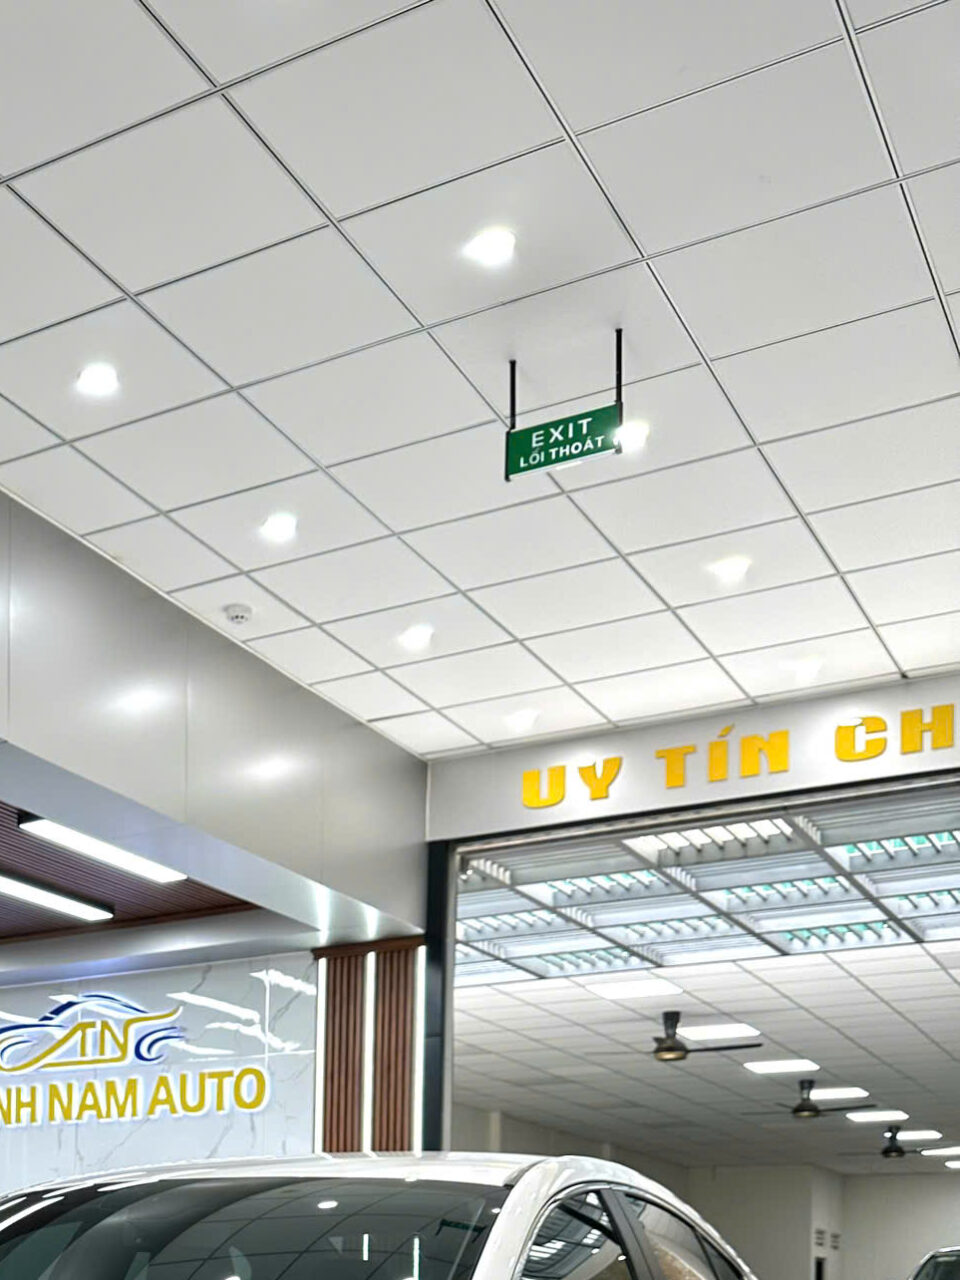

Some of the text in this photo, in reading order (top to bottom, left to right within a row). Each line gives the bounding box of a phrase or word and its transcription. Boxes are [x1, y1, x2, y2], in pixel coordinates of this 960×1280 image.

[531, 417, 593, 448] EXIT
[548, 435, 606, 461] THOÁT
[522, 756, 623, 809] UY
[655, 723, 791, 789] TÍN
[48, 1078, 138, 1122] NAM
[147, 1067, 267, 1116] AUTO
